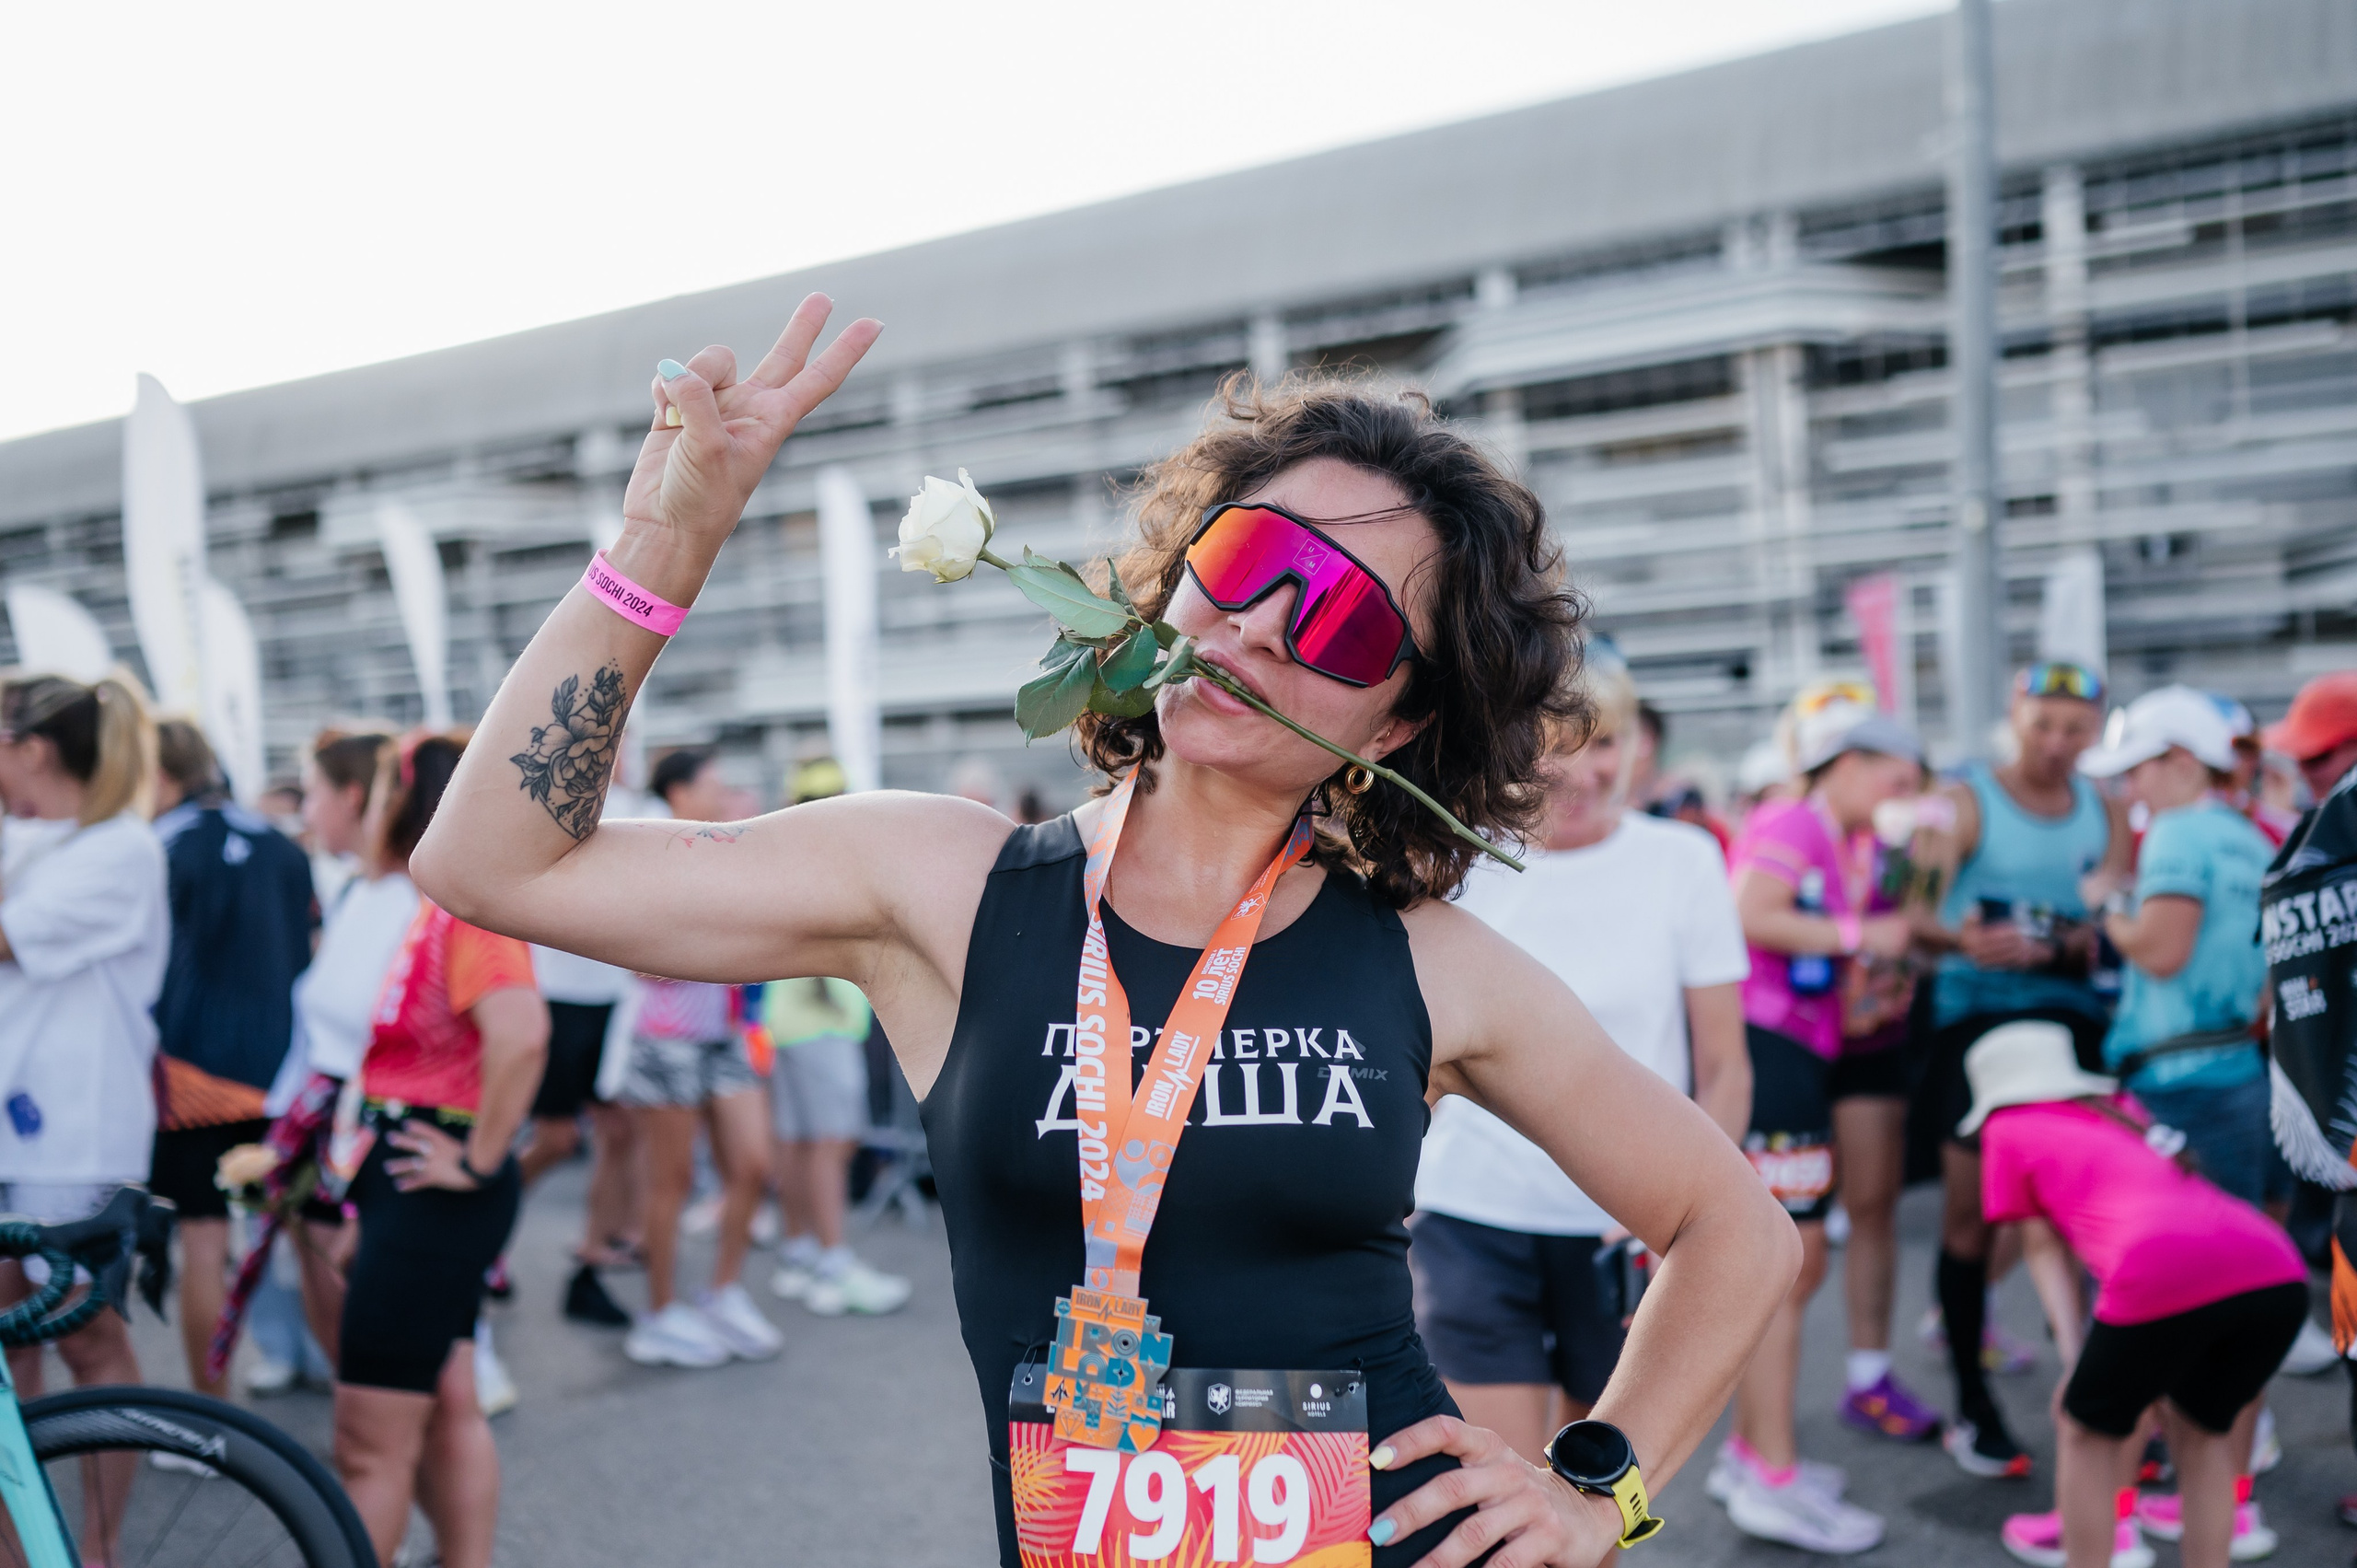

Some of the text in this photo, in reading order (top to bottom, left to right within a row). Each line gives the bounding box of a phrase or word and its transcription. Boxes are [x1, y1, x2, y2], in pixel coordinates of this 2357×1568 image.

[596, 572, 626, 600] SOCHI
[622, 592, 655, 617] 2024
[1192, 979, 1220, 1000] 10
[1214, 947, 1247, 1005] SIRIUS SOCHI
[1075, 912, 1110, 1202] SIRIUS SOCHI 2024
[1144, 1030, 1193, 1119] IRON LADY
[1035, 1063, 1375, 1140] ДША
[1075, 1292, 1143, 1318] IRON LADY
[1302, 1401, 1331, 1411] SIRIUS
[1065, 1447, 1311, 1564] 7919
